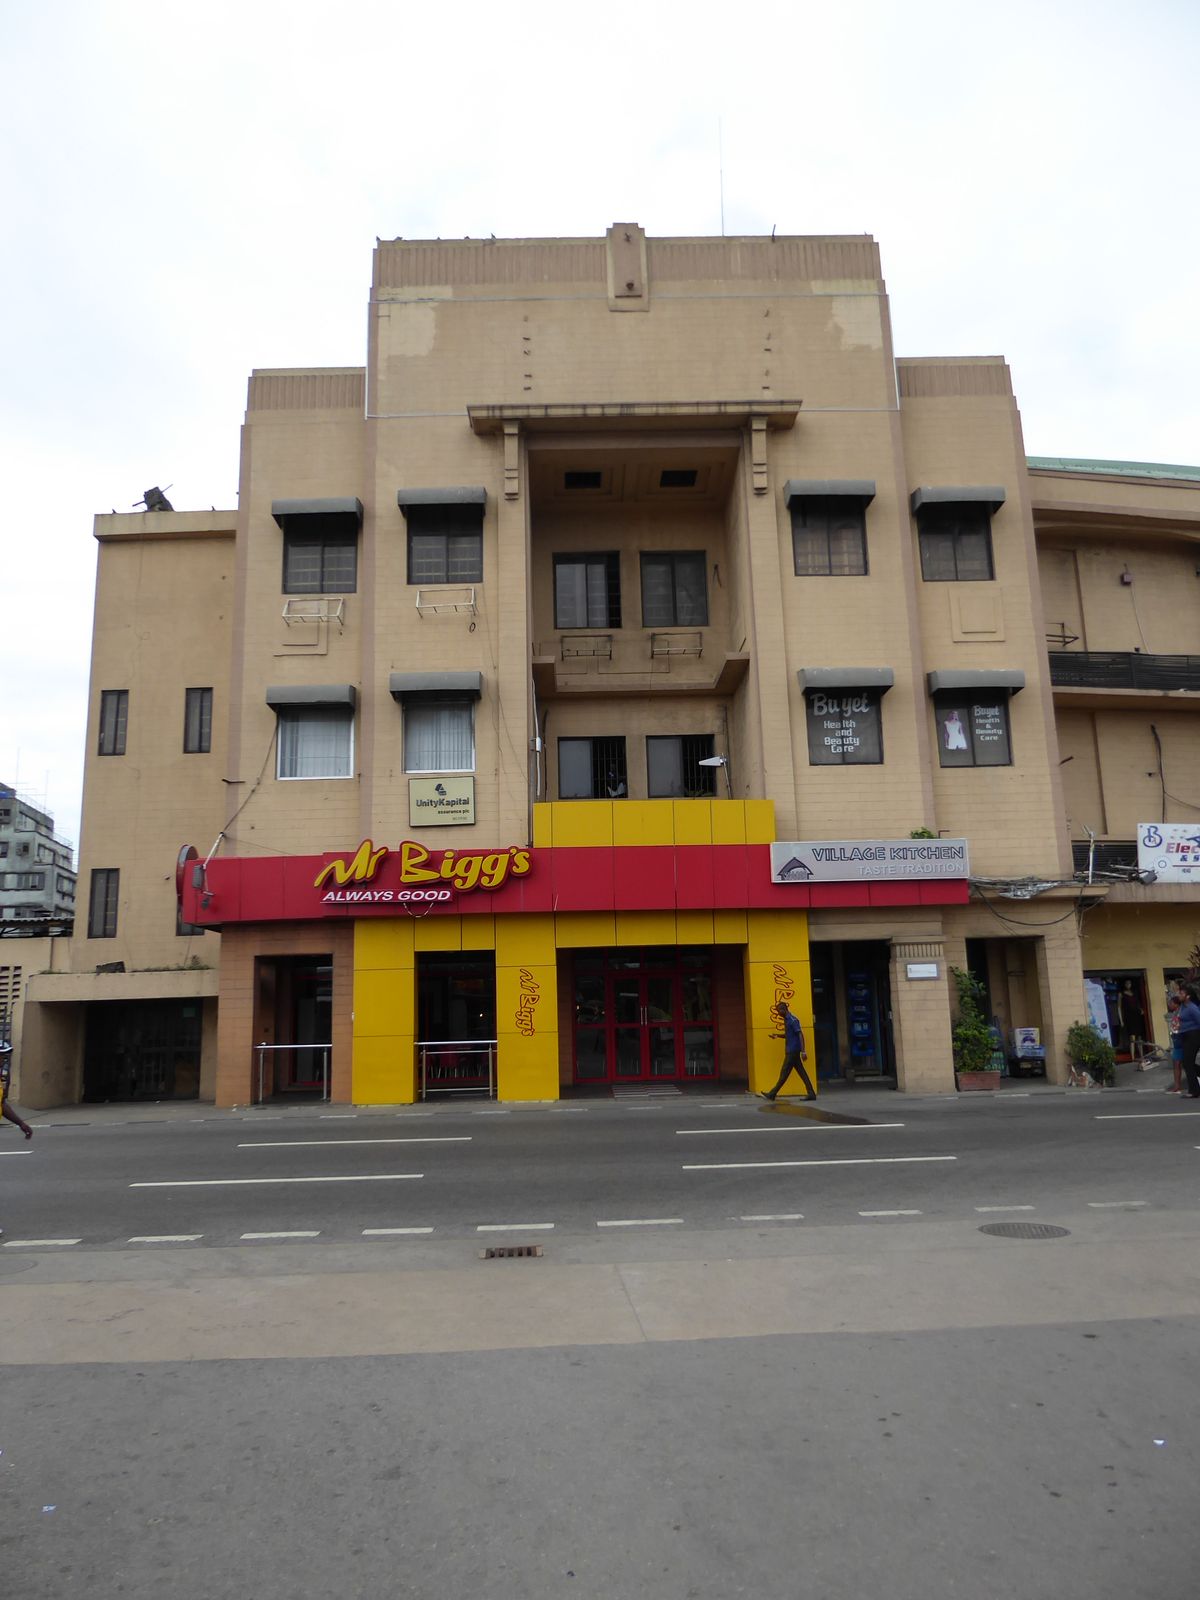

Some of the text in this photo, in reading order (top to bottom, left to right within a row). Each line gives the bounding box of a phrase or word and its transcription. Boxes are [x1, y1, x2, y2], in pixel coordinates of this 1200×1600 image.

[823, 720, 856, 729] Health
[835, 728, 853, 737] and
[824, 736, 860, 746] Beauty
[831, 745, 855, 753] Care
[416, 797, 470, 808] UnityKapital
[812, 846, 964, 862] VILLAGE KITCHEN
[313, 839, 532, 891] Mr Bigg's
[857, 862, 965, 876] TASTE TRADITION
[322, 889, 451, 901] ALWAYS GOOD
[519, 968, 540, 993] Mr
[773, 963, 794, 988] Mr
